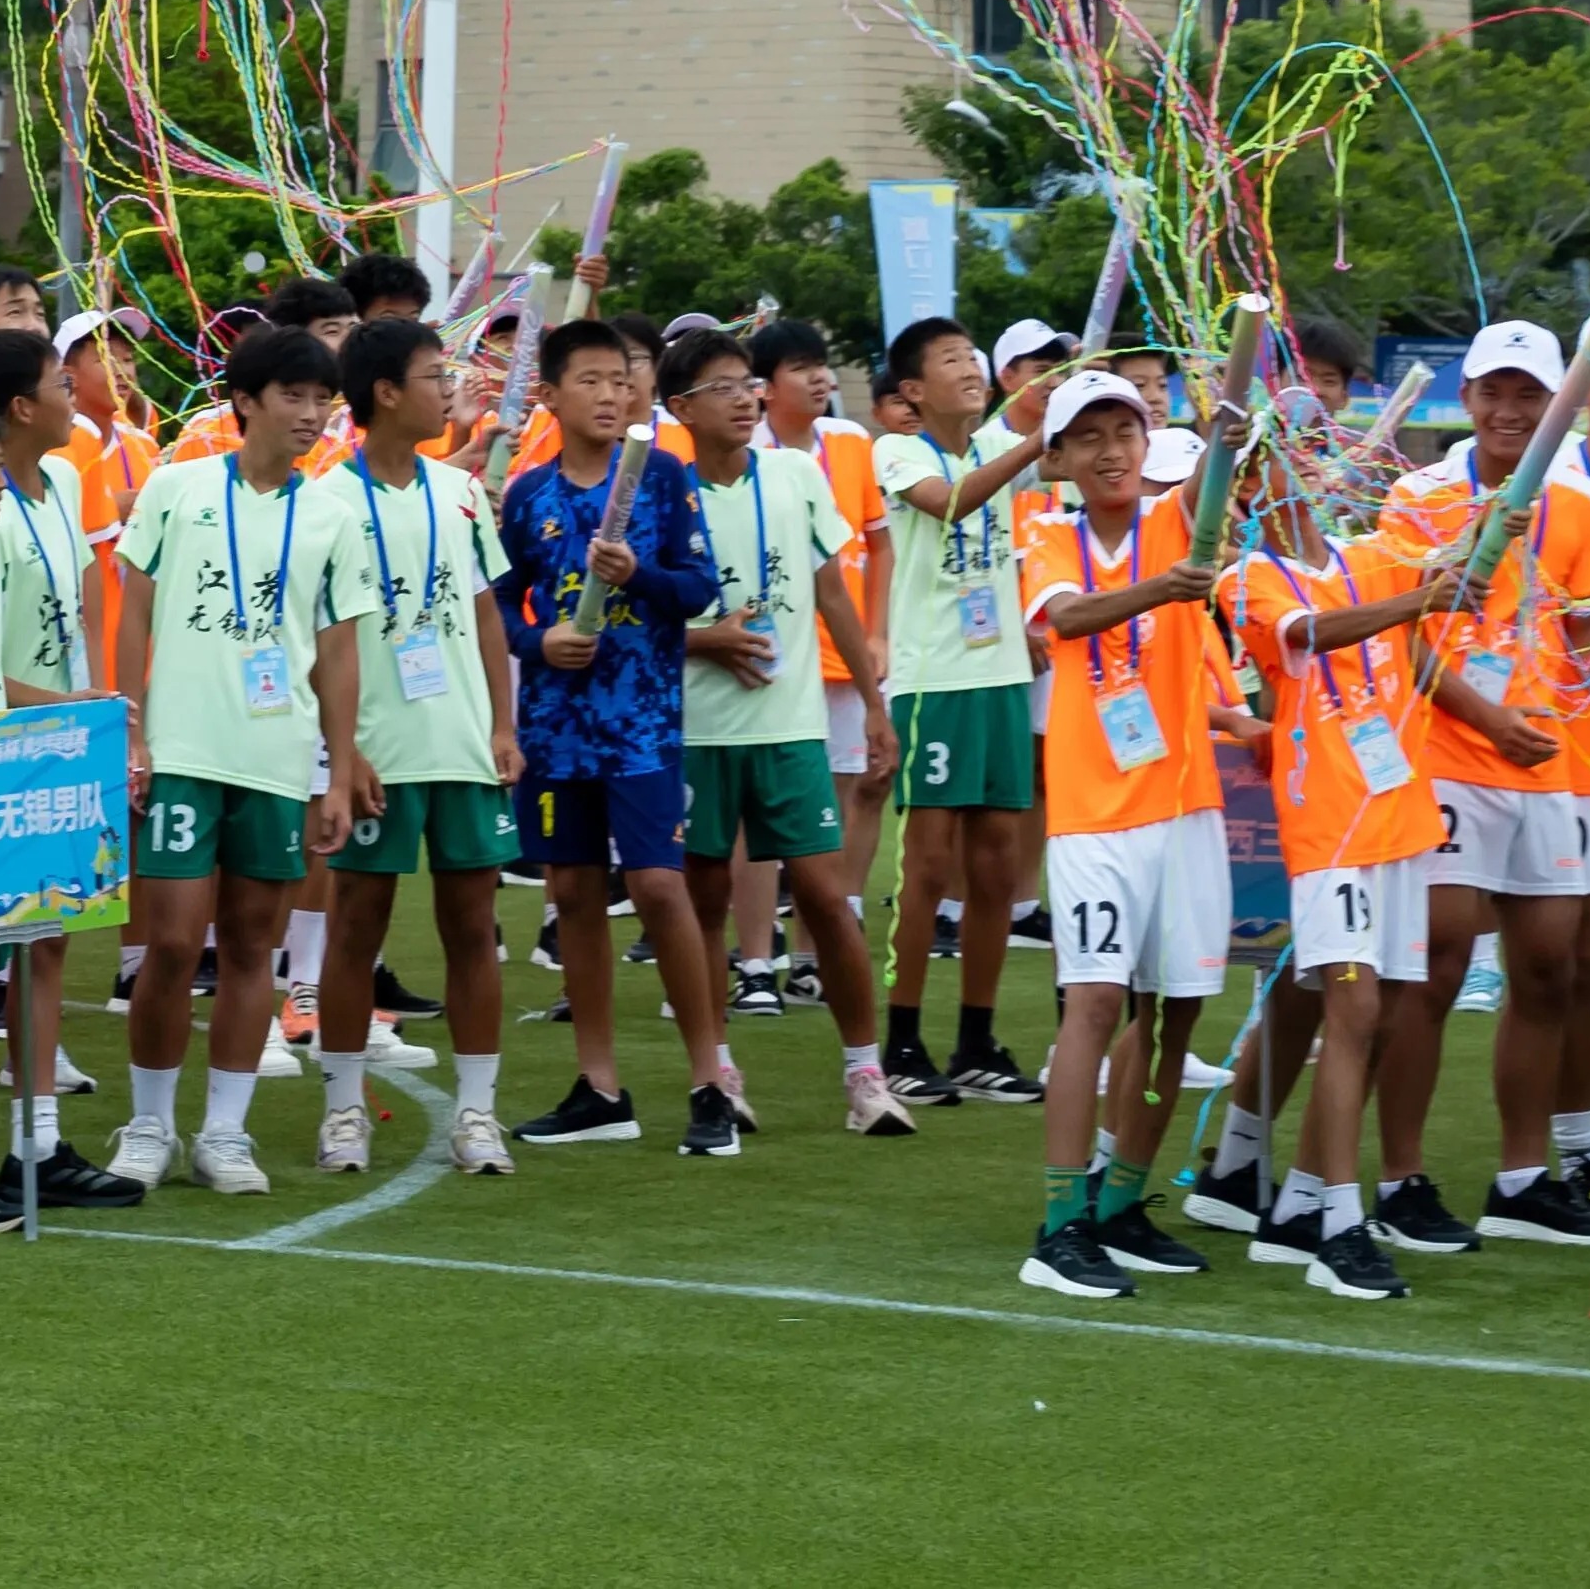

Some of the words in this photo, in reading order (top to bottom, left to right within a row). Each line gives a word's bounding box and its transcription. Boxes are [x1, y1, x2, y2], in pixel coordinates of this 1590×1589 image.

[925, 741, 950, 784] 3
[147, 802, 197, 852] 13
[538, 791, 555, 837] 1
[1072, 900, 1122, 954] 12
